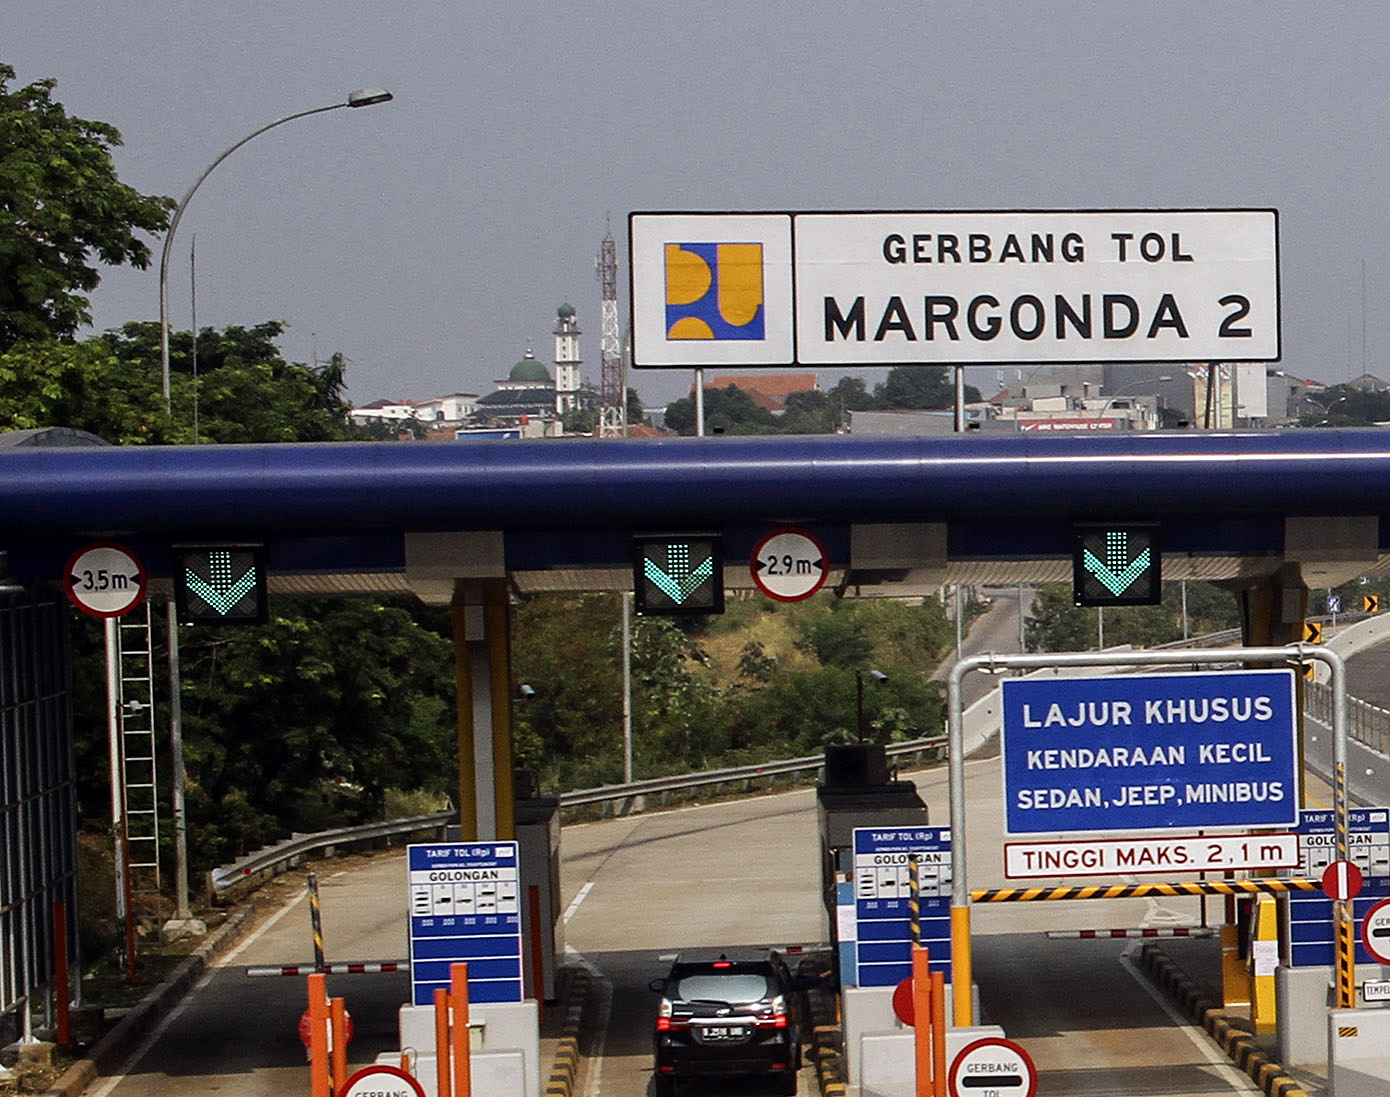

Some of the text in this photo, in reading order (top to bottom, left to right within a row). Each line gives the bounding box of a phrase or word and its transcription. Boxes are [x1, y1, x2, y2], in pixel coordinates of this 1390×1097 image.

[882, 232, 1195, 264] GERBANG TOL
[823, 293, 1253, 343] MARGONDA 2
[1022, 696, 1273, 728] LAJUR KHUSUS
[1027, 742, 1272, 770] KENDARAAN KECIL
[1304, 814, 1327, 823] TARIF
[872, 833, 896, 841] TARIF
[898, 833, 914, 841] TOL
[1307, 834, 1373, 846] GOLOGAN
[426, 849, 451, 858] TARIF
[454, 848, 471, 857] TOL
[1022, 850, 1105, 870] TINGGI
[1116, 846, 1195, 868] MAKS.
[874, 854, 942, 865] GOLOGAN
[429, 870, 499, 882] GOLONGAN
[967, 1062, 1018, 1073] GERBANG
